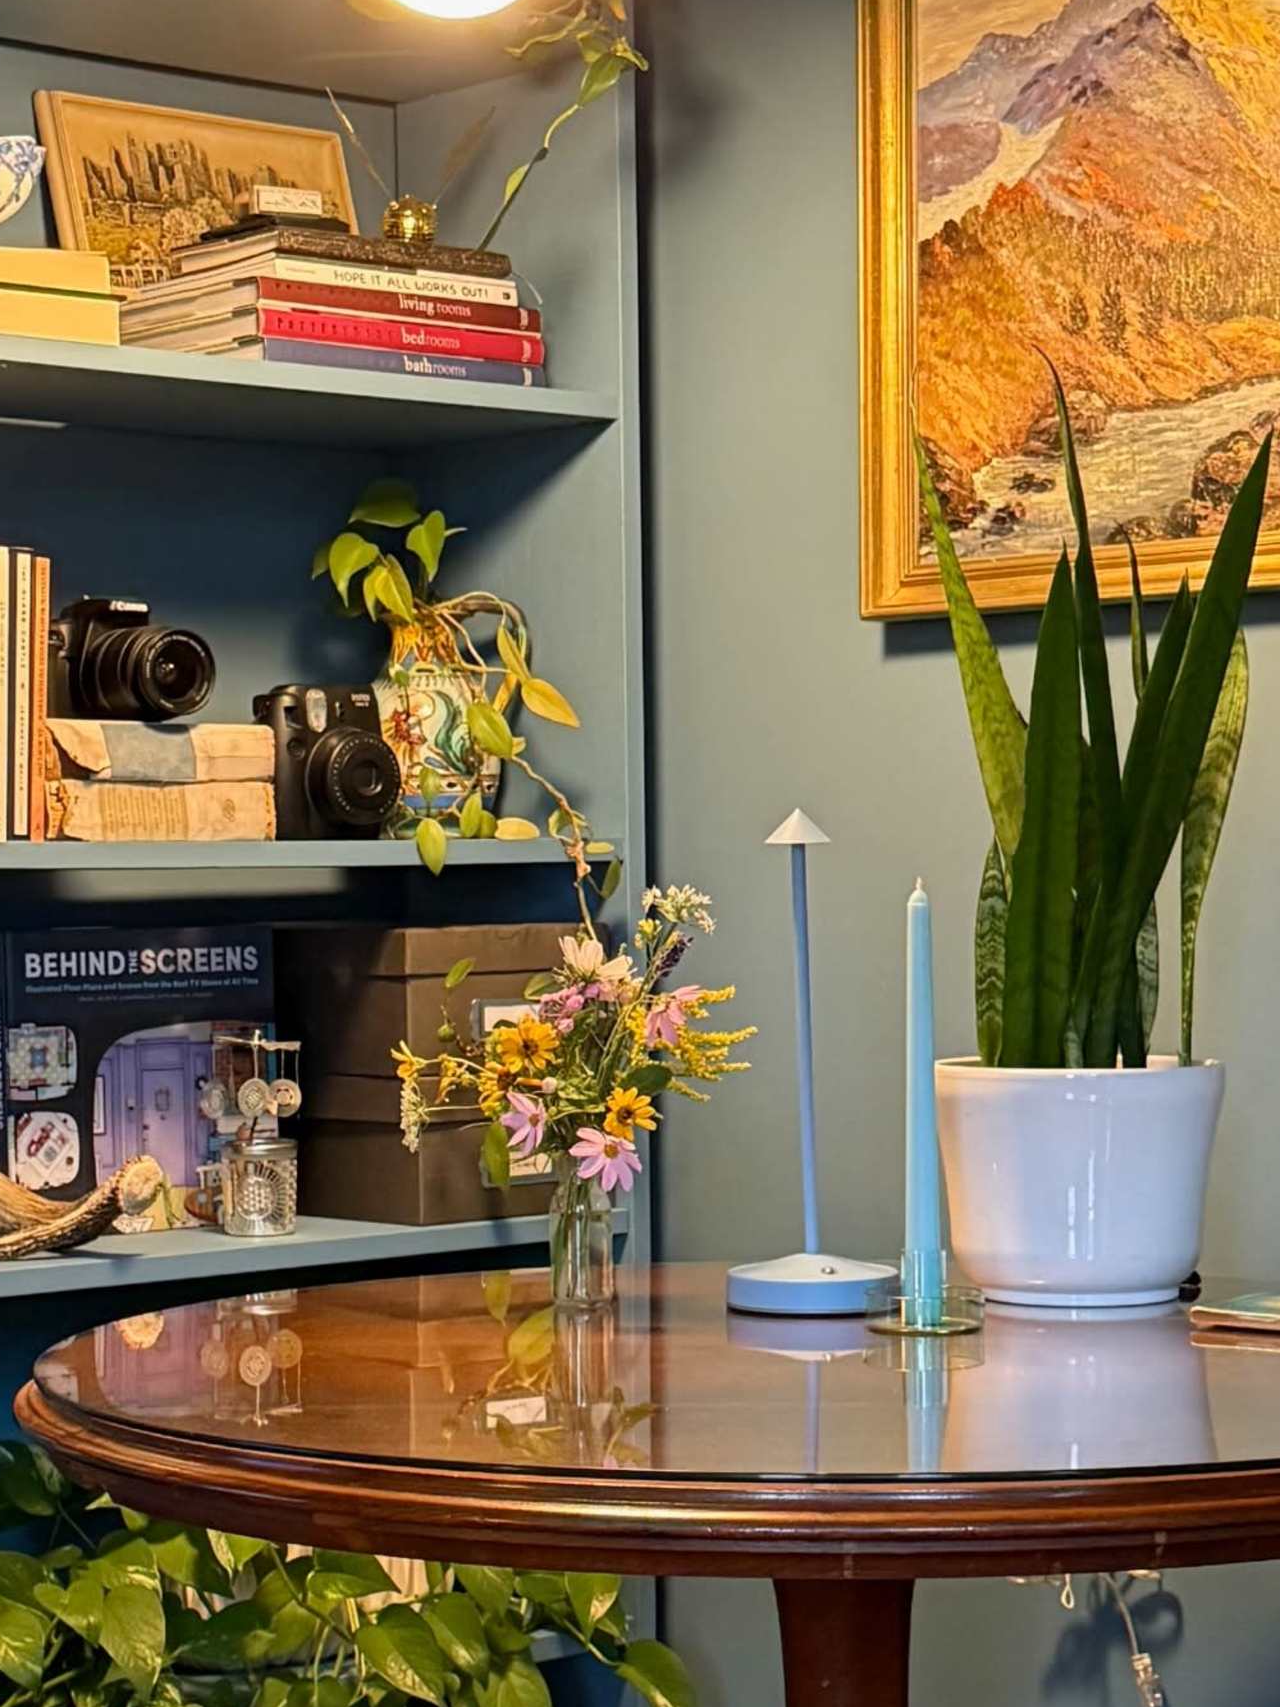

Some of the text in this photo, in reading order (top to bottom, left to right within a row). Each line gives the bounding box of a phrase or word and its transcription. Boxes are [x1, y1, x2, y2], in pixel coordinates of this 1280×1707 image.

[334, 269, 489, 300] HOPE IT ALL WORKS OUT!
[398, 294, 471, 317] living rooms
[401, 326, 461, 350] bedrooms
[404, 353, 468, 377] bathrooms
[24, 950, 126, 979] BEHIND
[128, 949, 139, 975] THE
[140, 946, 259, 975] SCREENS
